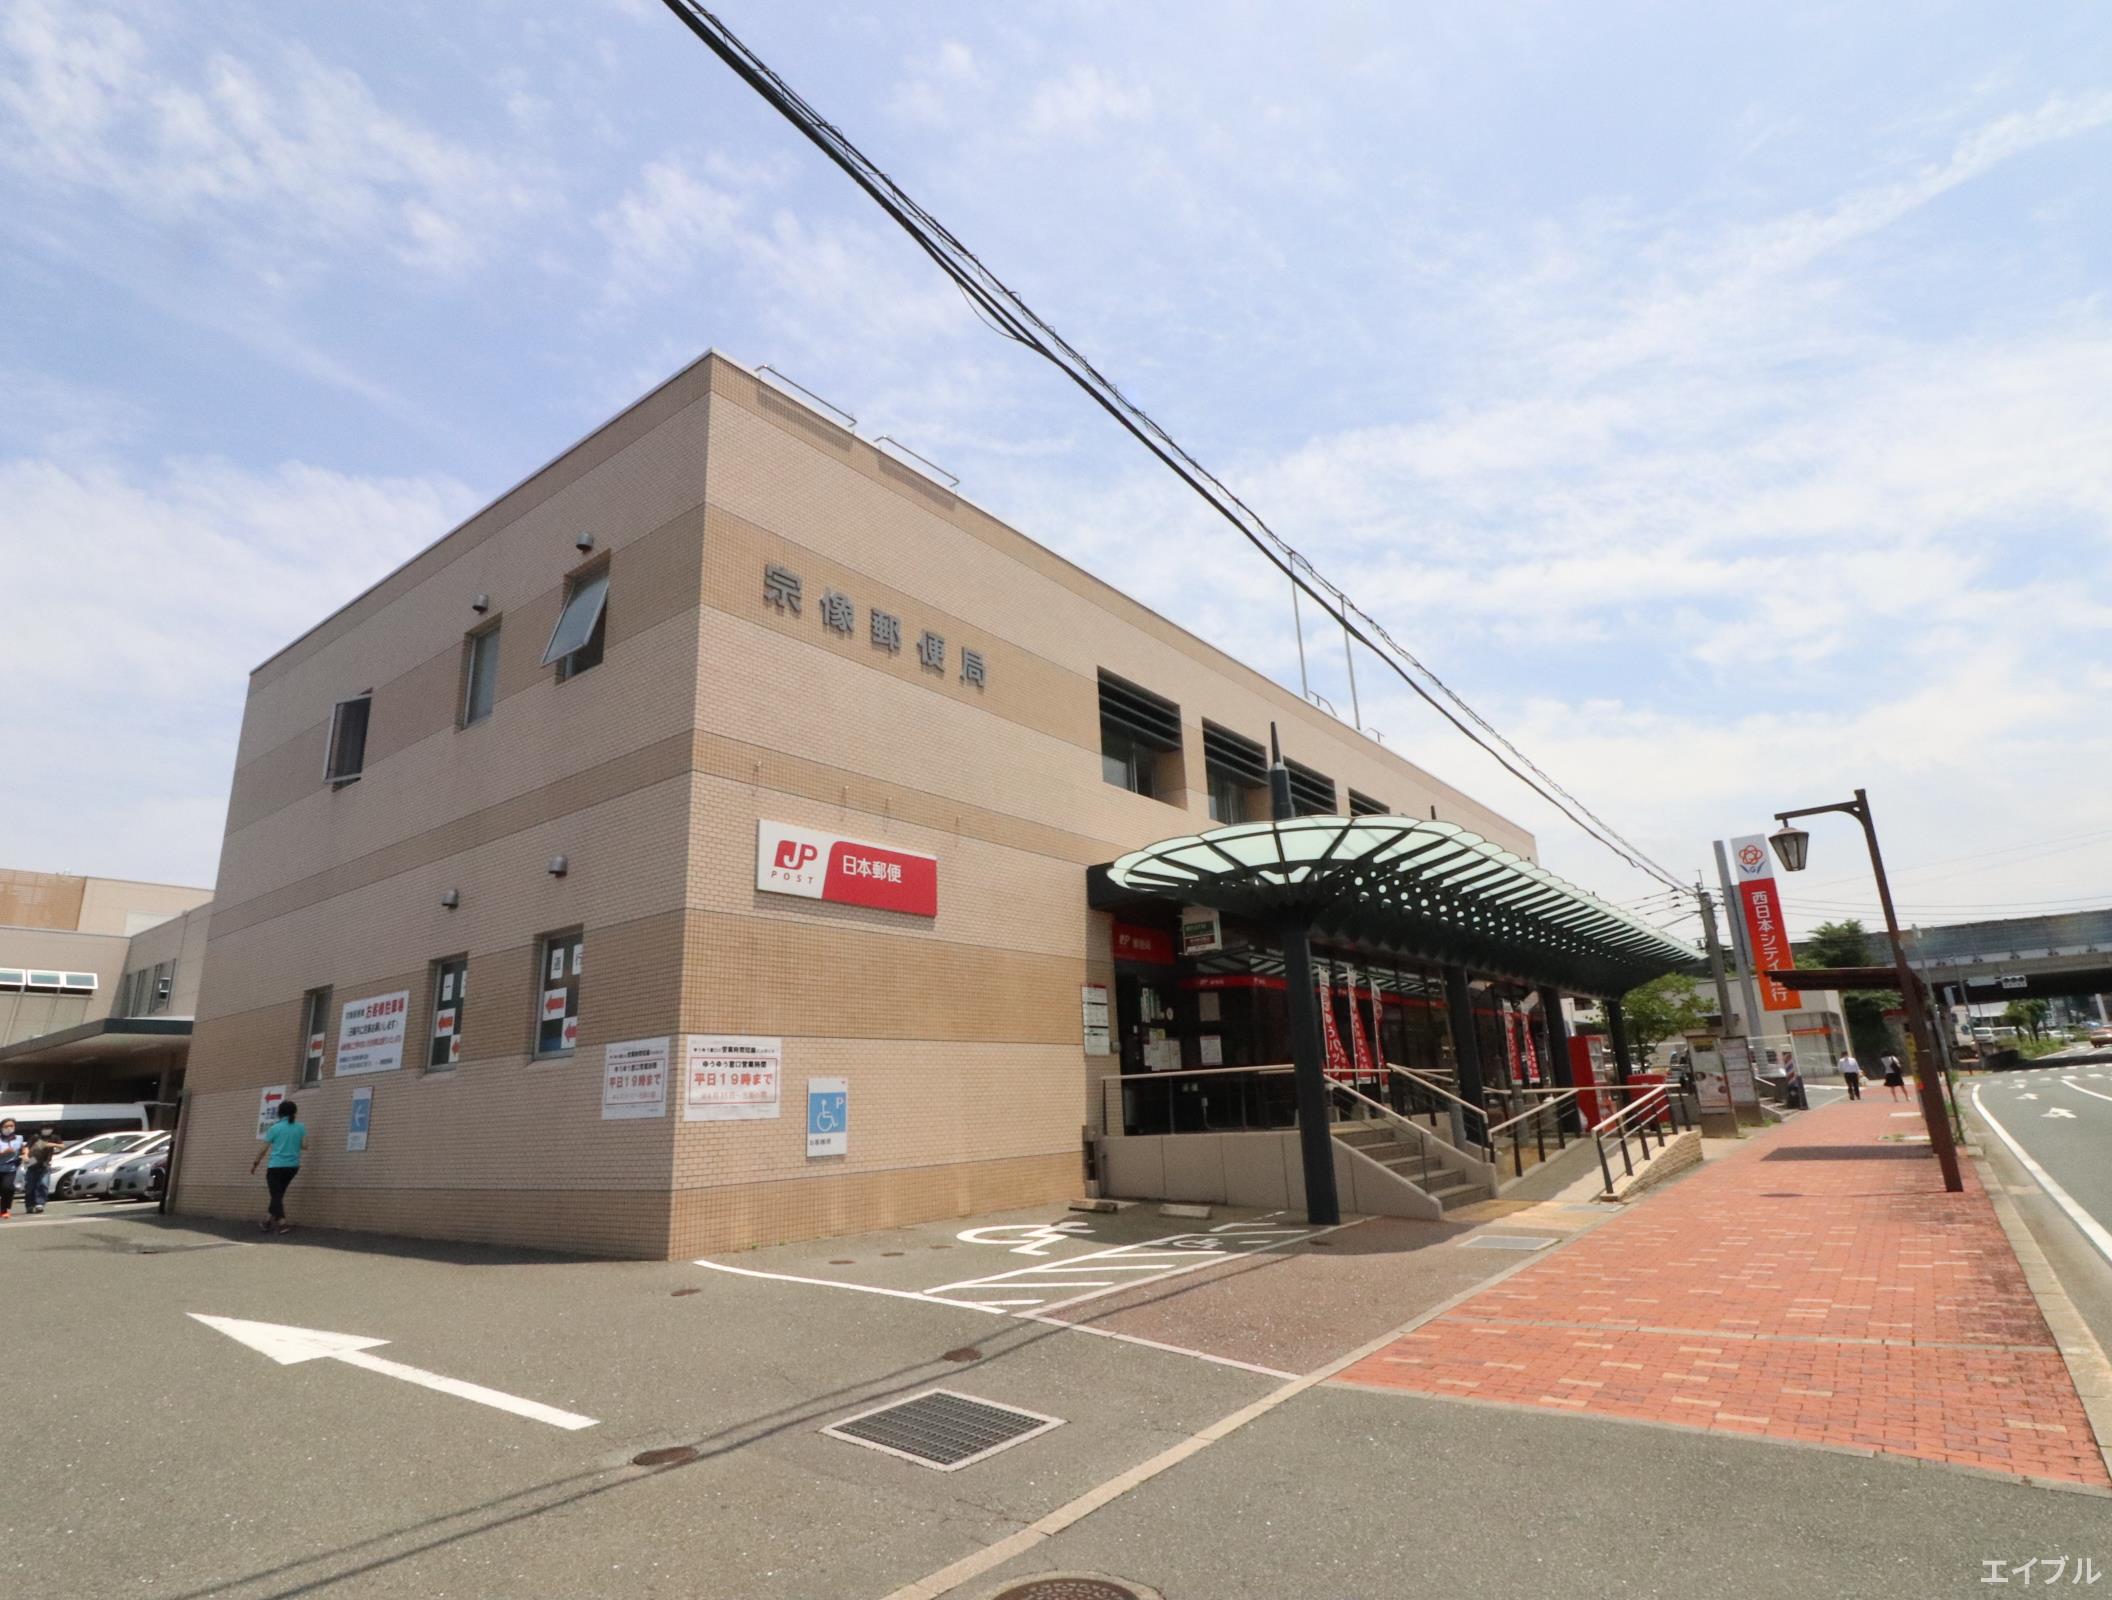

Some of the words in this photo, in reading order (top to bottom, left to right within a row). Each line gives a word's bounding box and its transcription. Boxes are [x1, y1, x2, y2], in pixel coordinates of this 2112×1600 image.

[764, 563, 986, 692] 宗像郵便局
[774, 840, 818, 870] JP
[842, 855, 903, 883] 日本郵便
[771, 871, 814, 884] POST
[1752, 891, 1787, 1002] 西日本シティ行
[694, 1072, 773, 1087] 平日19時まで
[836, 1096, 844, 1110] P
